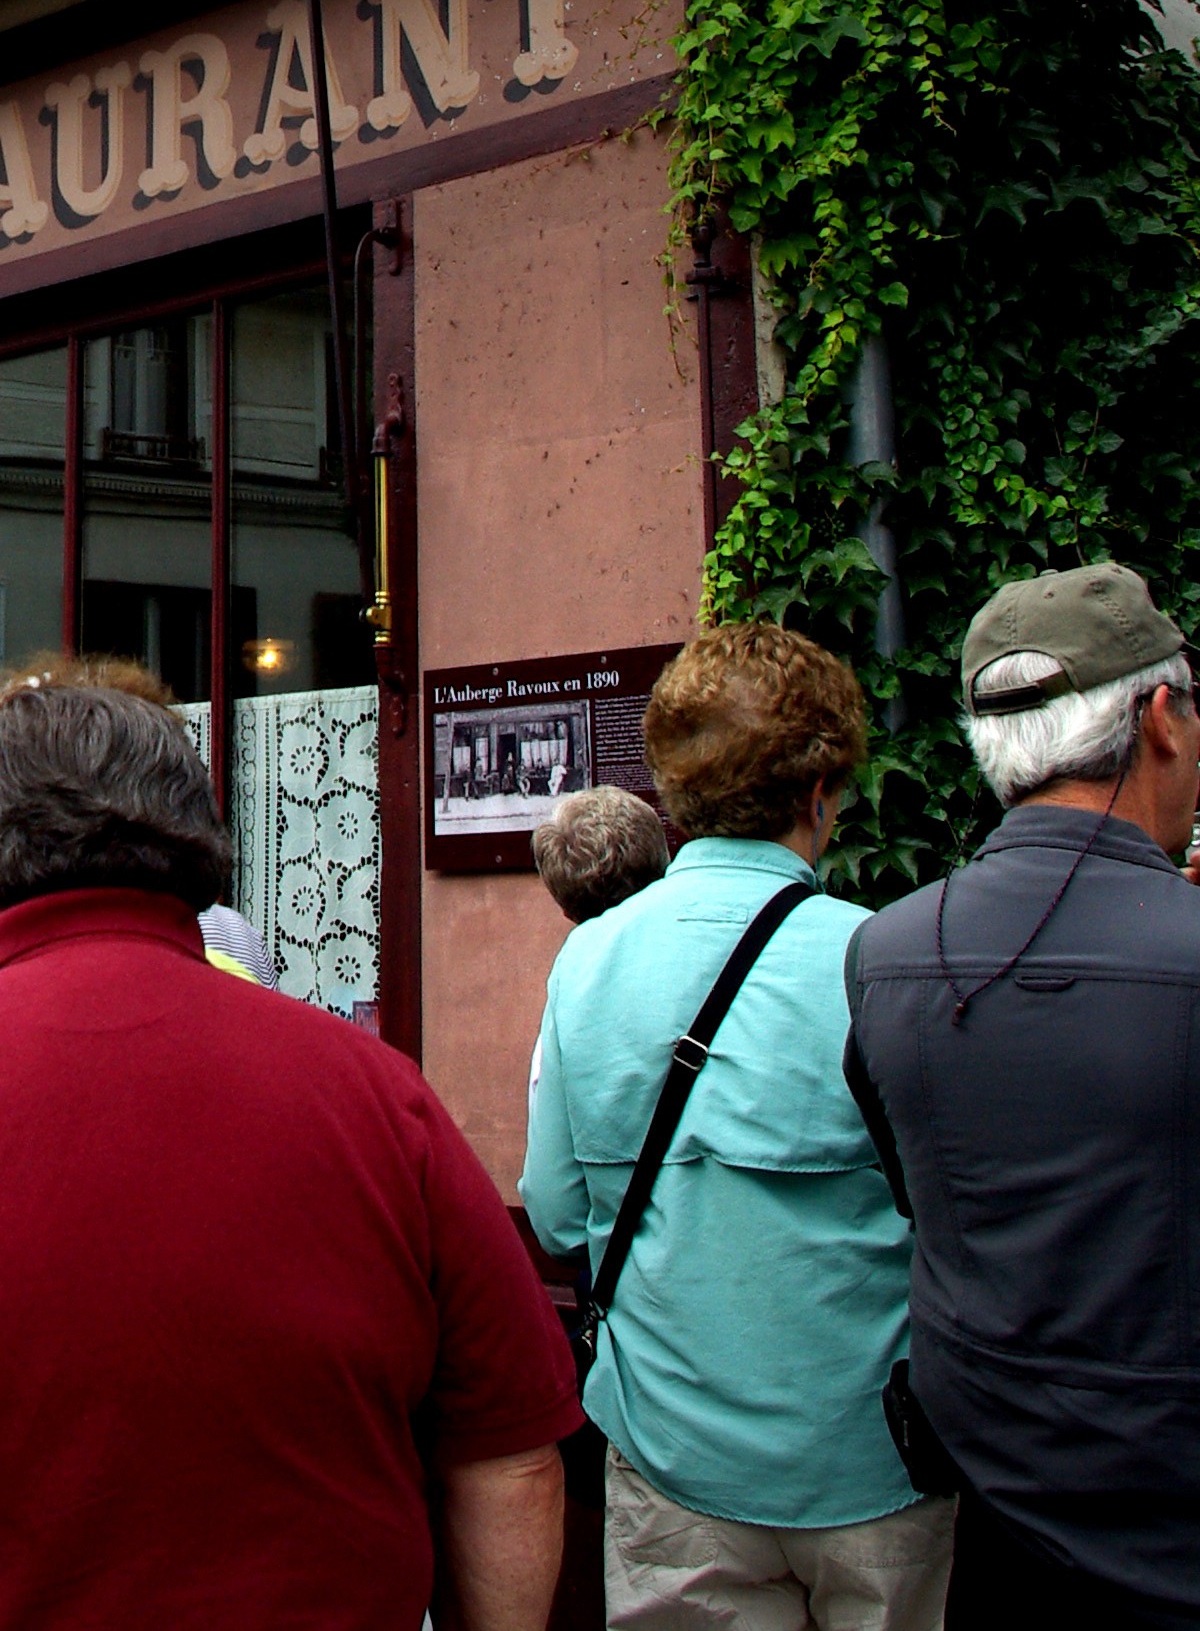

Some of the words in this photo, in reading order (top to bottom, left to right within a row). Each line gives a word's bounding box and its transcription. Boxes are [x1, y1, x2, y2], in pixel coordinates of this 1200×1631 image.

[434, 683, 503, 704] L'Auberge
[507, 680, 560, 697] Ravoux
[563, 679, 581, 691] en
[586, 670, 620, 689] 1890
